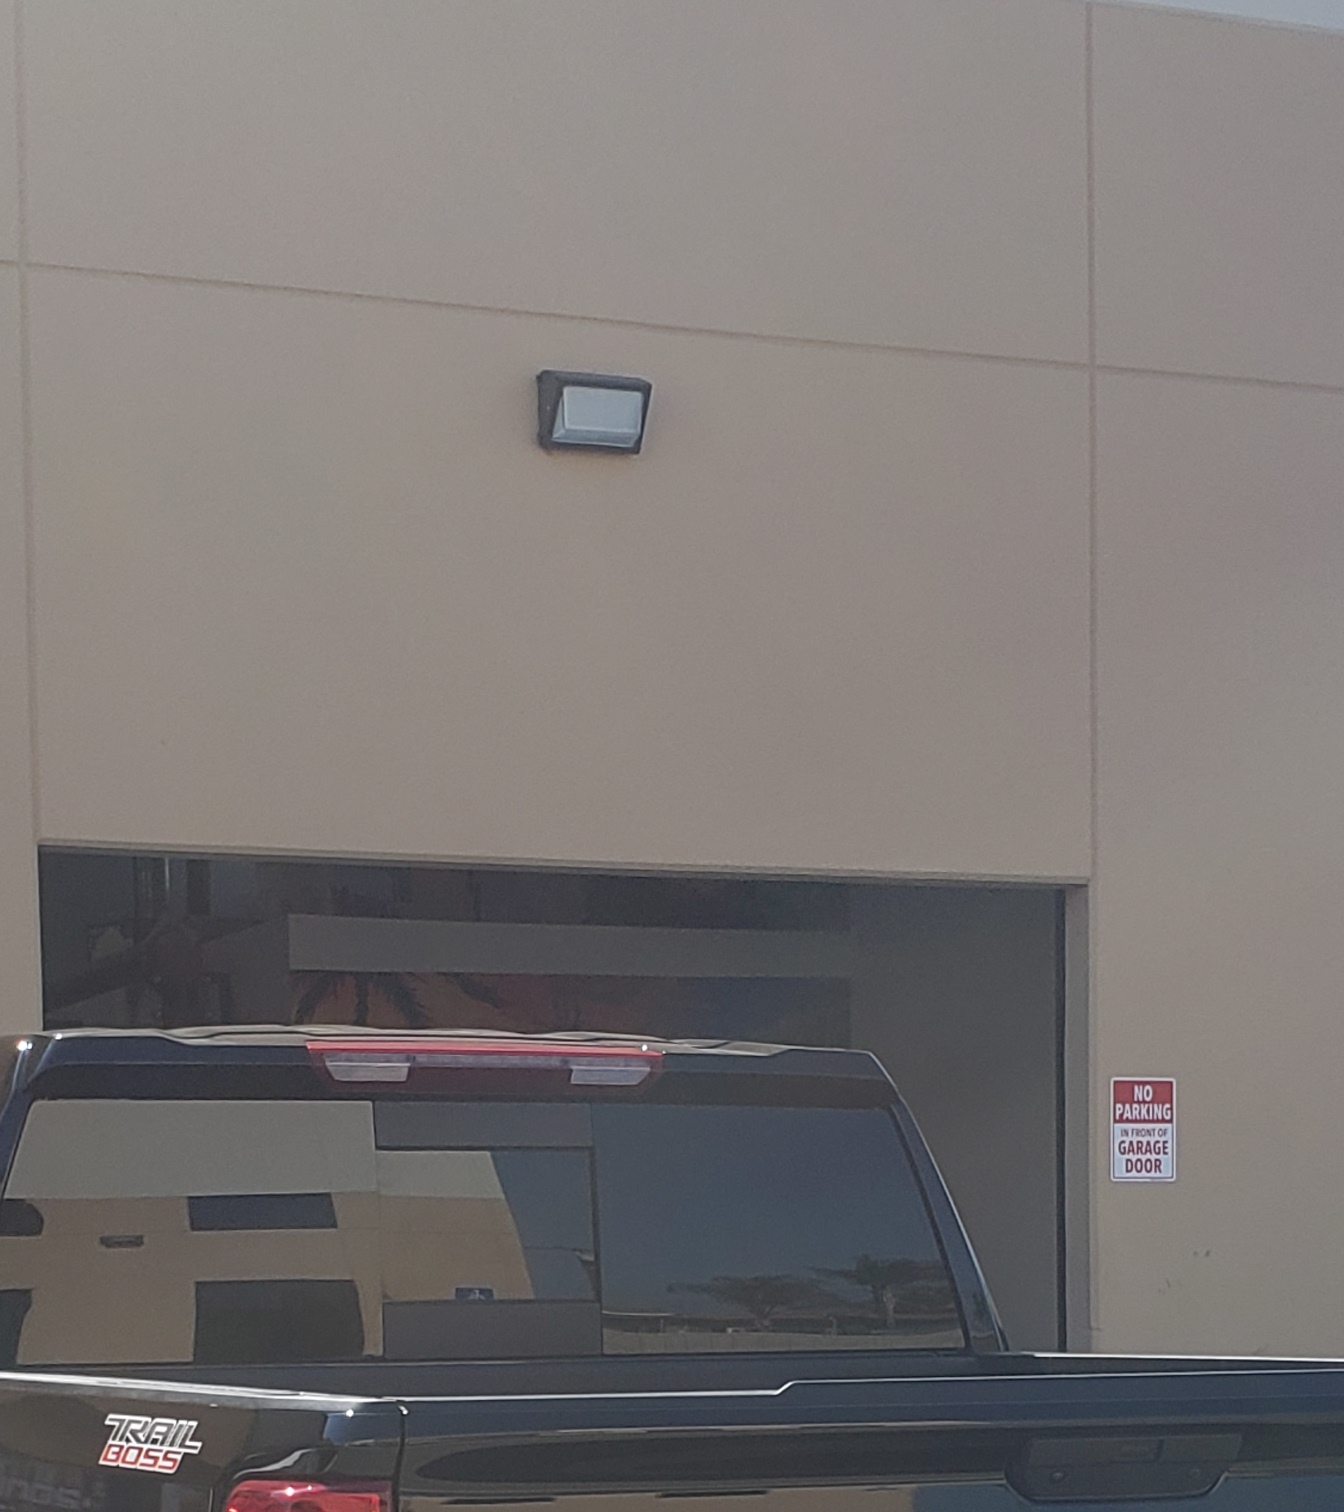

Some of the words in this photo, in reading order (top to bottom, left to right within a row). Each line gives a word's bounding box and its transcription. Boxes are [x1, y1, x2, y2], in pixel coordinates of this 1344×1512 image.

[1134, 1085, 1153, 1102] NO
[1115, 1103, 1172, 1121] PARKING
[1120, 1128, 1129, 1138] IN
[1131, 1128, 1156, 1138] FRONT
[1157, 1128, 1169, 1138] OF
[1118, 1140, 1169, 1156] GARAGE
[1125, 1158, 1162, 1174] DOOR
[104, 1413, 203, 1454] TRAIL
[98, 1443, 184, 1475] BOSS
